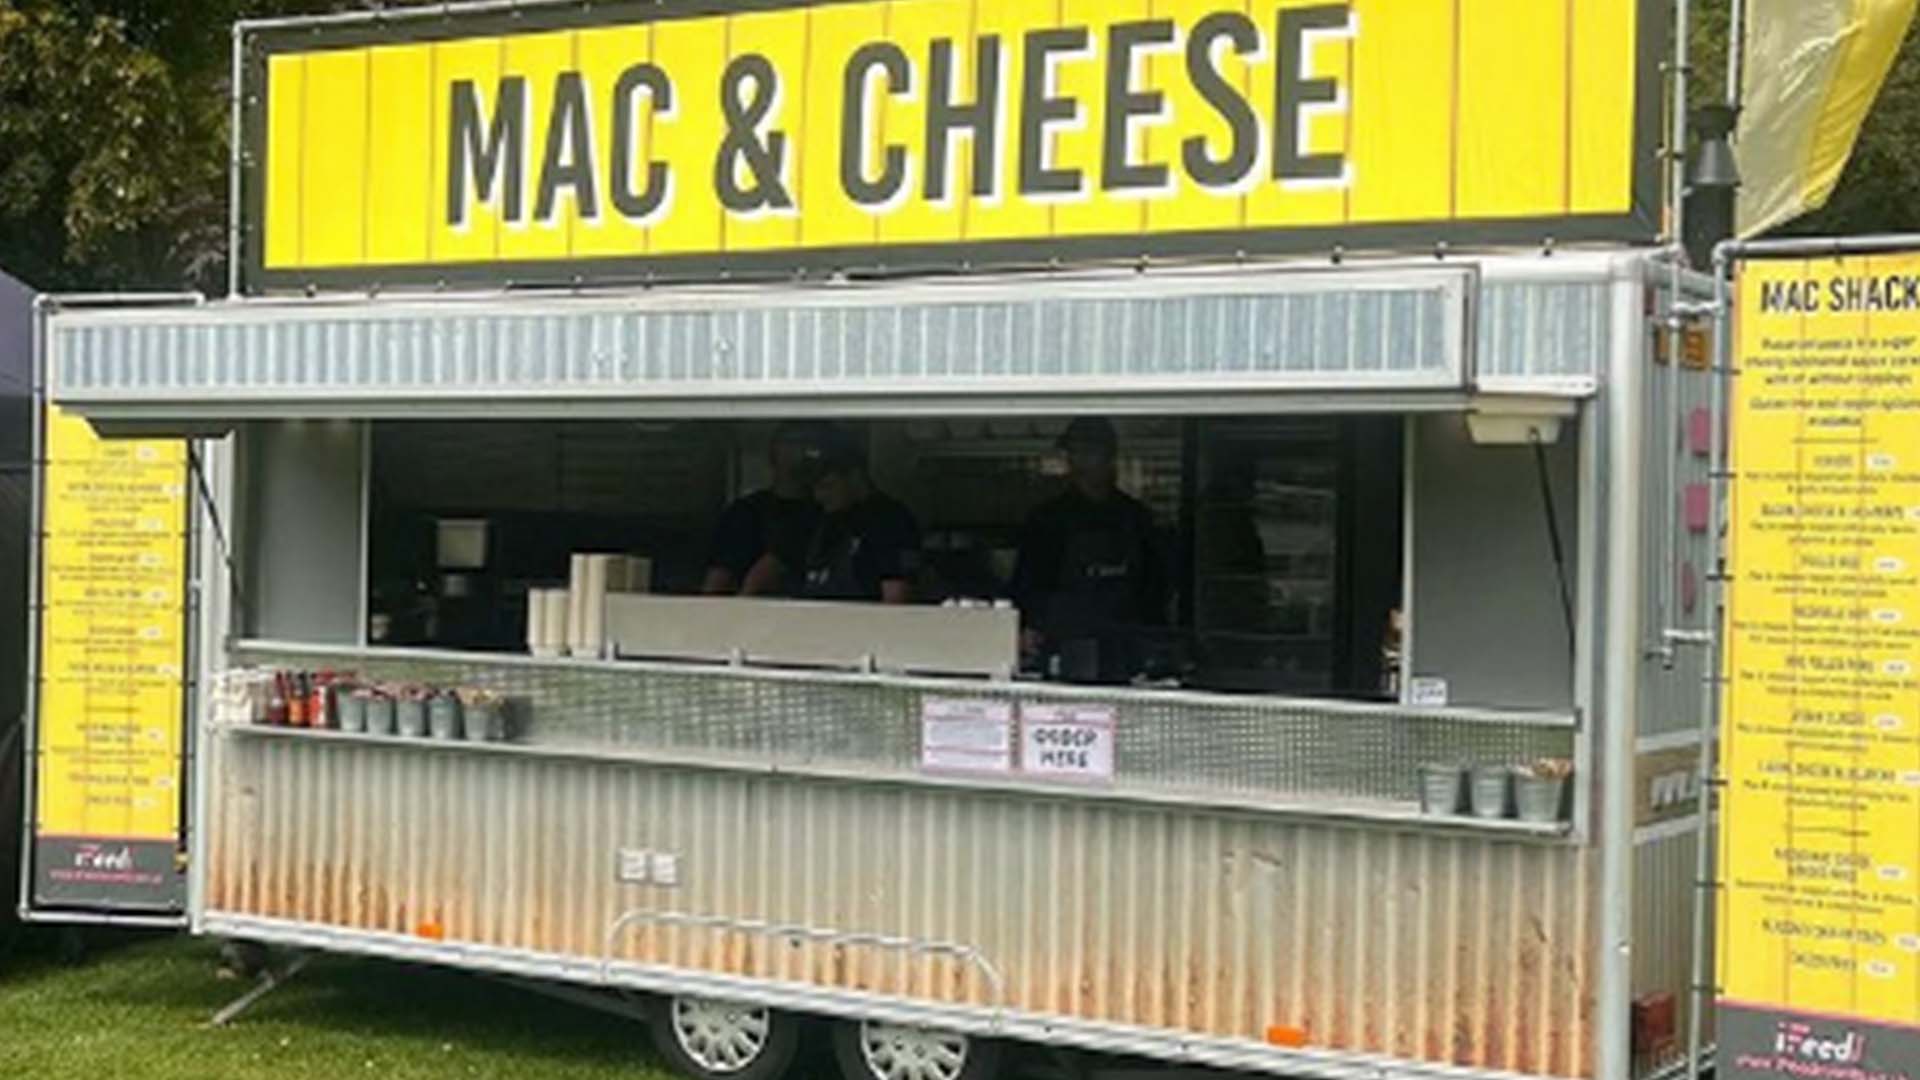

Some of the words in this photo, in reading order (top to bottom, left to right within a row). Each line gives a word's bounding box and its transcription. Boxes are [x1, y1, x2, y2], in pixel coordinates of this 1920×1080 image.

[446, 62, 674, 228] MAC
[715, 53, 794, 214] &
[840, 2, 1356, 207] CHEESE
[1761, 280, 1819, 312] MAC
[1829, 274, 1920, 311] SHACK
